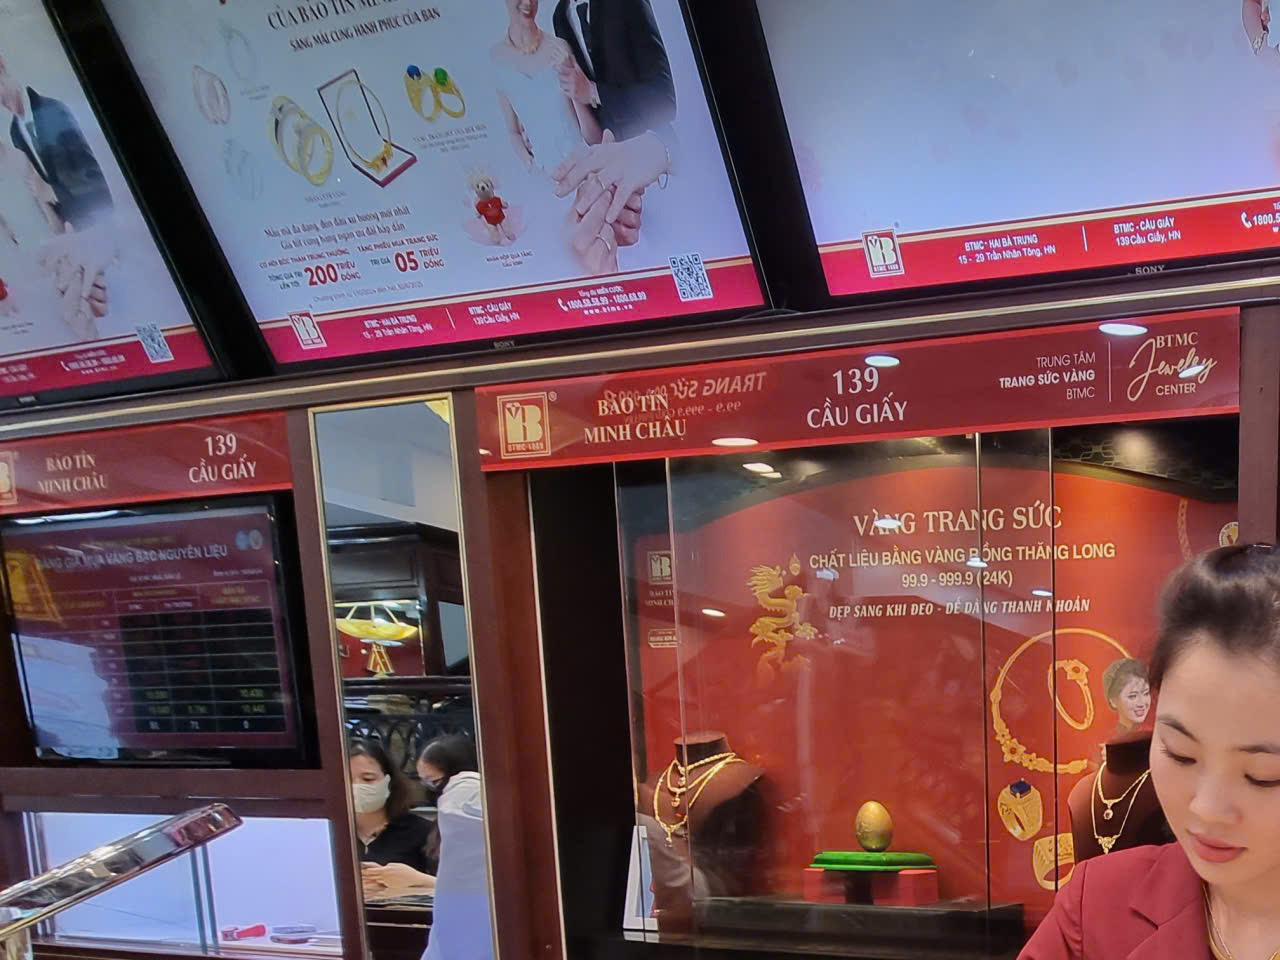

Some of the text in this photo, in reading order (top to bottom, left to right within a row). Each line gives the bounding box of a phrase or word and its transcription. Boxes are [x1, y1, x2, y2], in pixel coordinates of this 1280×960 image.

[1114, 222, 1134, 234] BTMC
[394, 251, 419, 272] 05
[1136, 265, 1164, 275] SONY
[304, 264, 338, 286] 200
[1156, 332, 1198, 348] BTMC
[1037, 351, 1096, 368] TRUNG TÂM
[832, 366, 880, 395] 139
[999, 368, 1096, 388] TRANG SỨC VÀNG
[1066, 387, 1095, 399] BTMC
[1156, 382, 1196, 396] CENTER
[807, 392, 908, 428] CẦU GIẤY
[584, 416, 686, 443] MINH CHÂU
[205, 433, 237, 456] 139
[188, 453, 256, 484] CẦU GIẤY
[923, 506, 1004, 534] TRANG
[1013, 500, 1062, 530] SỨC
[849, 550, 878, 568] LIỆU
[882, 544, 922, 565] BẰNG
[925, 544, 965, 564] VÀNG
[1015, 542, 1068, 561] THĂNG
[1073, 543, 1115, 559] LONG
[902, 573, 928, 587] 99.9
[940, 571, 973, 586] 999.9
[854, 600, 1041, 617] SANG KHI ĐEO THANH
